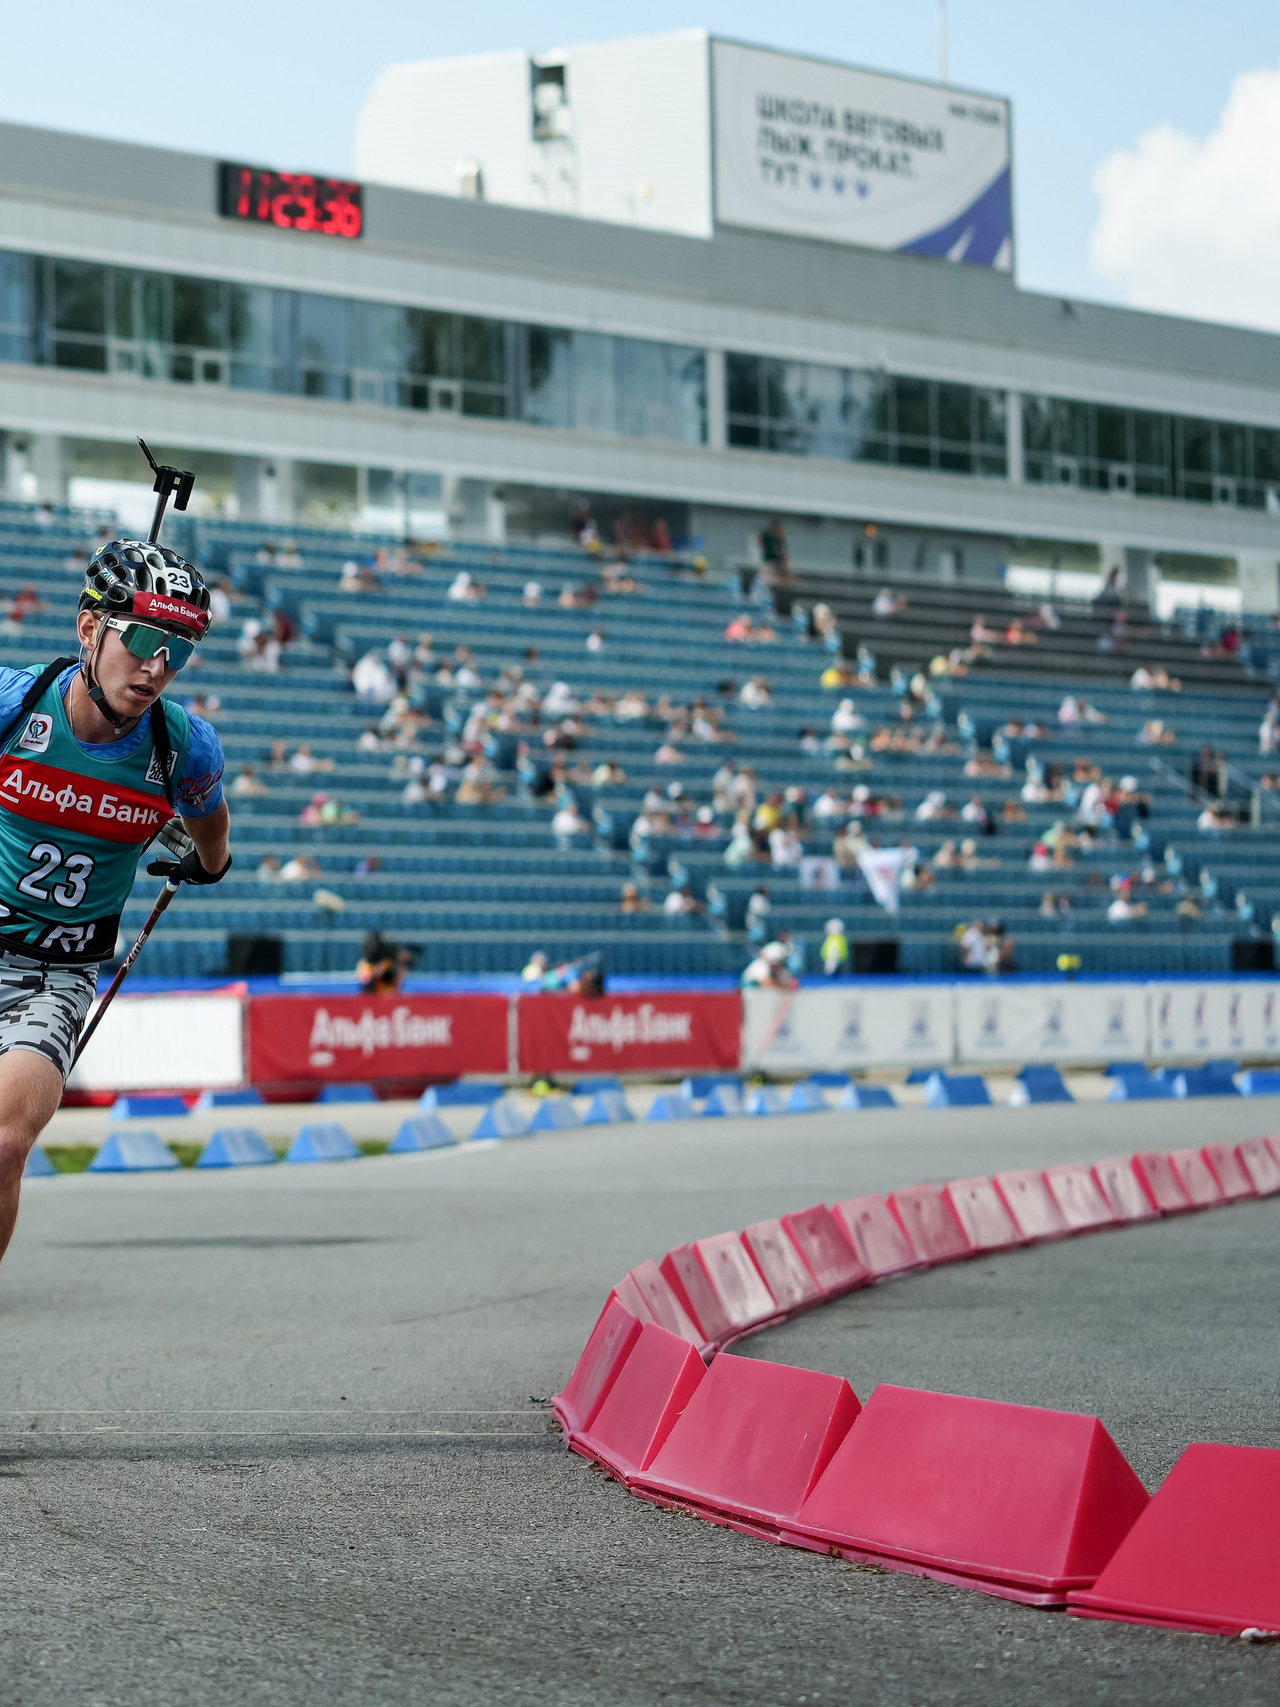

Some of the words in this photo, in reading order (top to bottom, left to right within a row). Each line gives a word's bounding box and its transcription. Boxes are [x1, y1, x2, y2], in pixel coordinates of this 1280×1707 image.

[756, 94, 837, 130] ШКОЛА
[842, 108, 946, 152] БЕГОВЫХ
[759, 157, 799, 188] ТУТ
[167, 572, 190, 589] 23
[149, 599, 180, 614] Альфа
[180, 606, 199, 621] Банк
[0, 769, 93, 813] Альфа
[97, 794, 161, 825] Банк
[17, 840, 96, 908] 23
[310, 1007, 391, 1057] Альфа
[391, 1006, 452, 1047] Банк
[570, 1005, 636, 1051] Альфа
[636, 1004, 693, 1044] Банк
